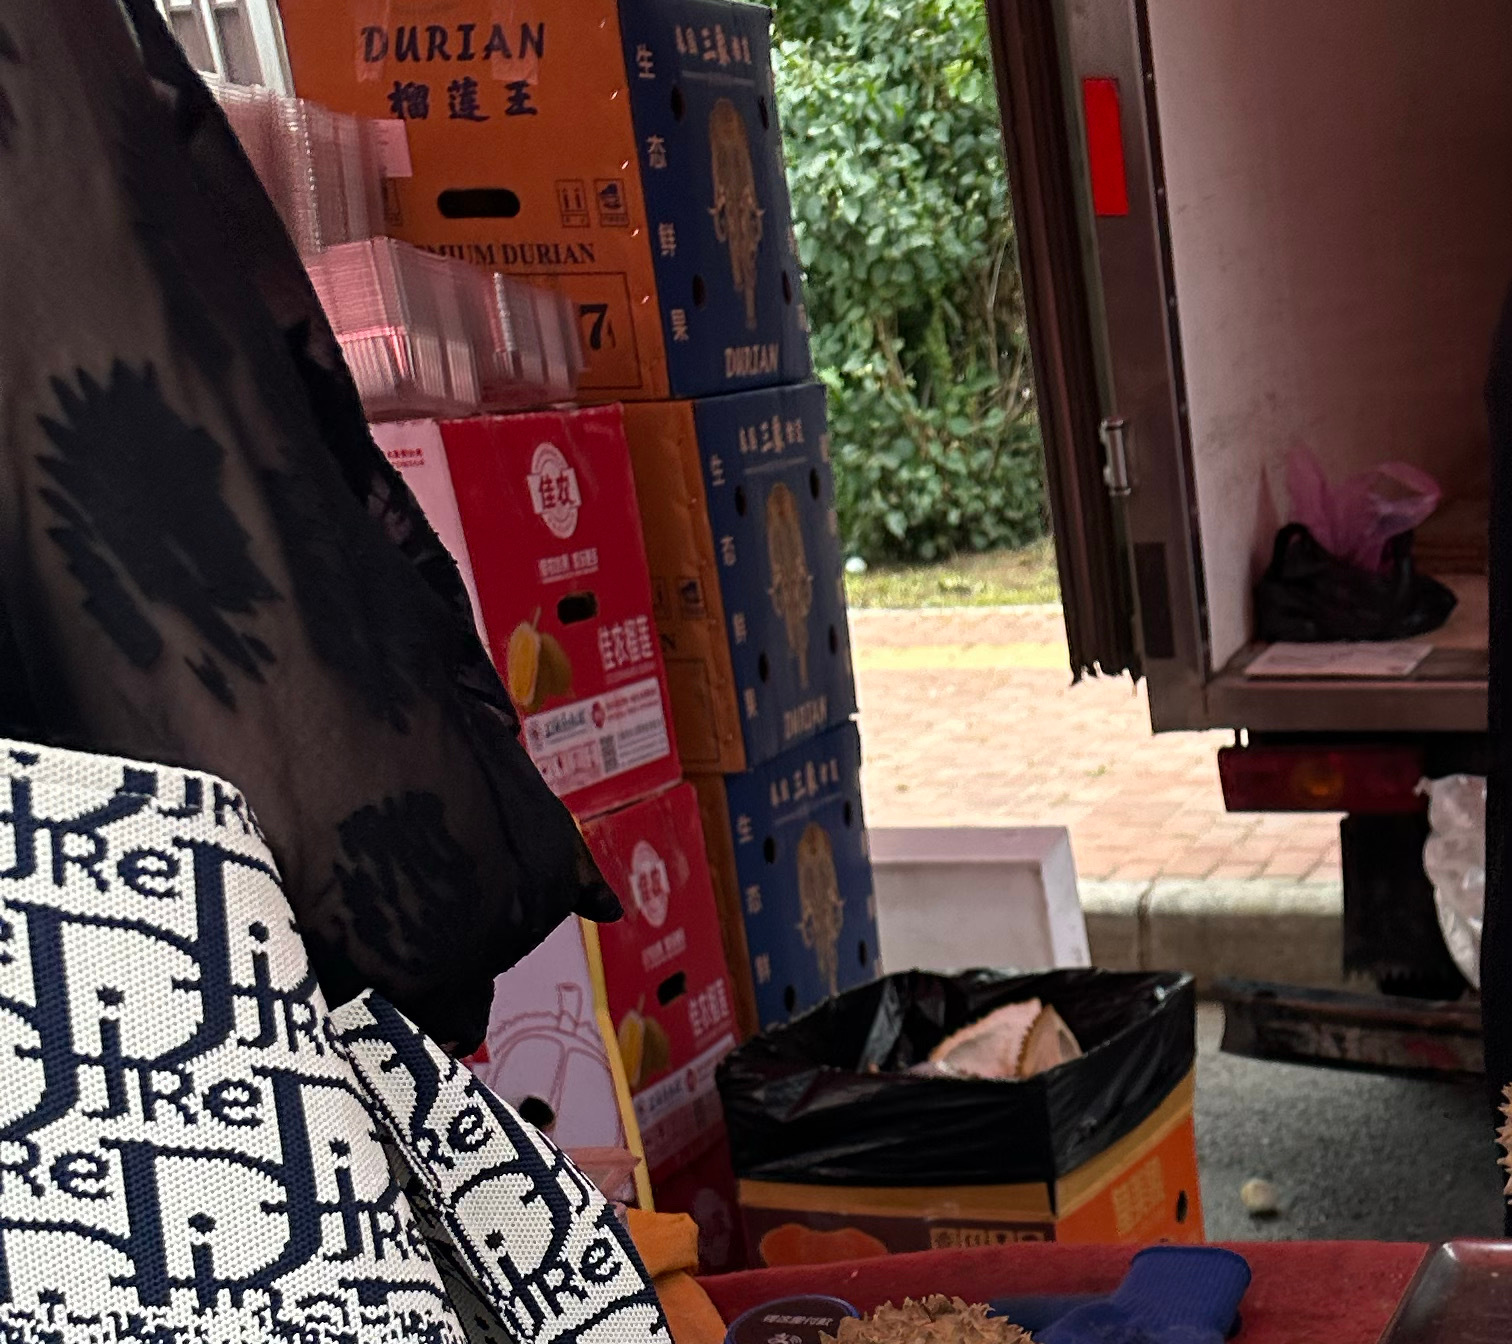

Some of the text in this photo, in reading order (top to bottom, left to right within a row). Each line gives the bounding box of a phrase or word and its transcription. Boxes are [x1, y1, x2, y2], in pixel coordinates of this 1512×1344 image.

[361, 22, 545, 63] DURIAN
[387, 76, 540, 122] 榴莲王
[503, 243, 596, 266] DURIAN
[725, 342, 780, 379] DURIAN
